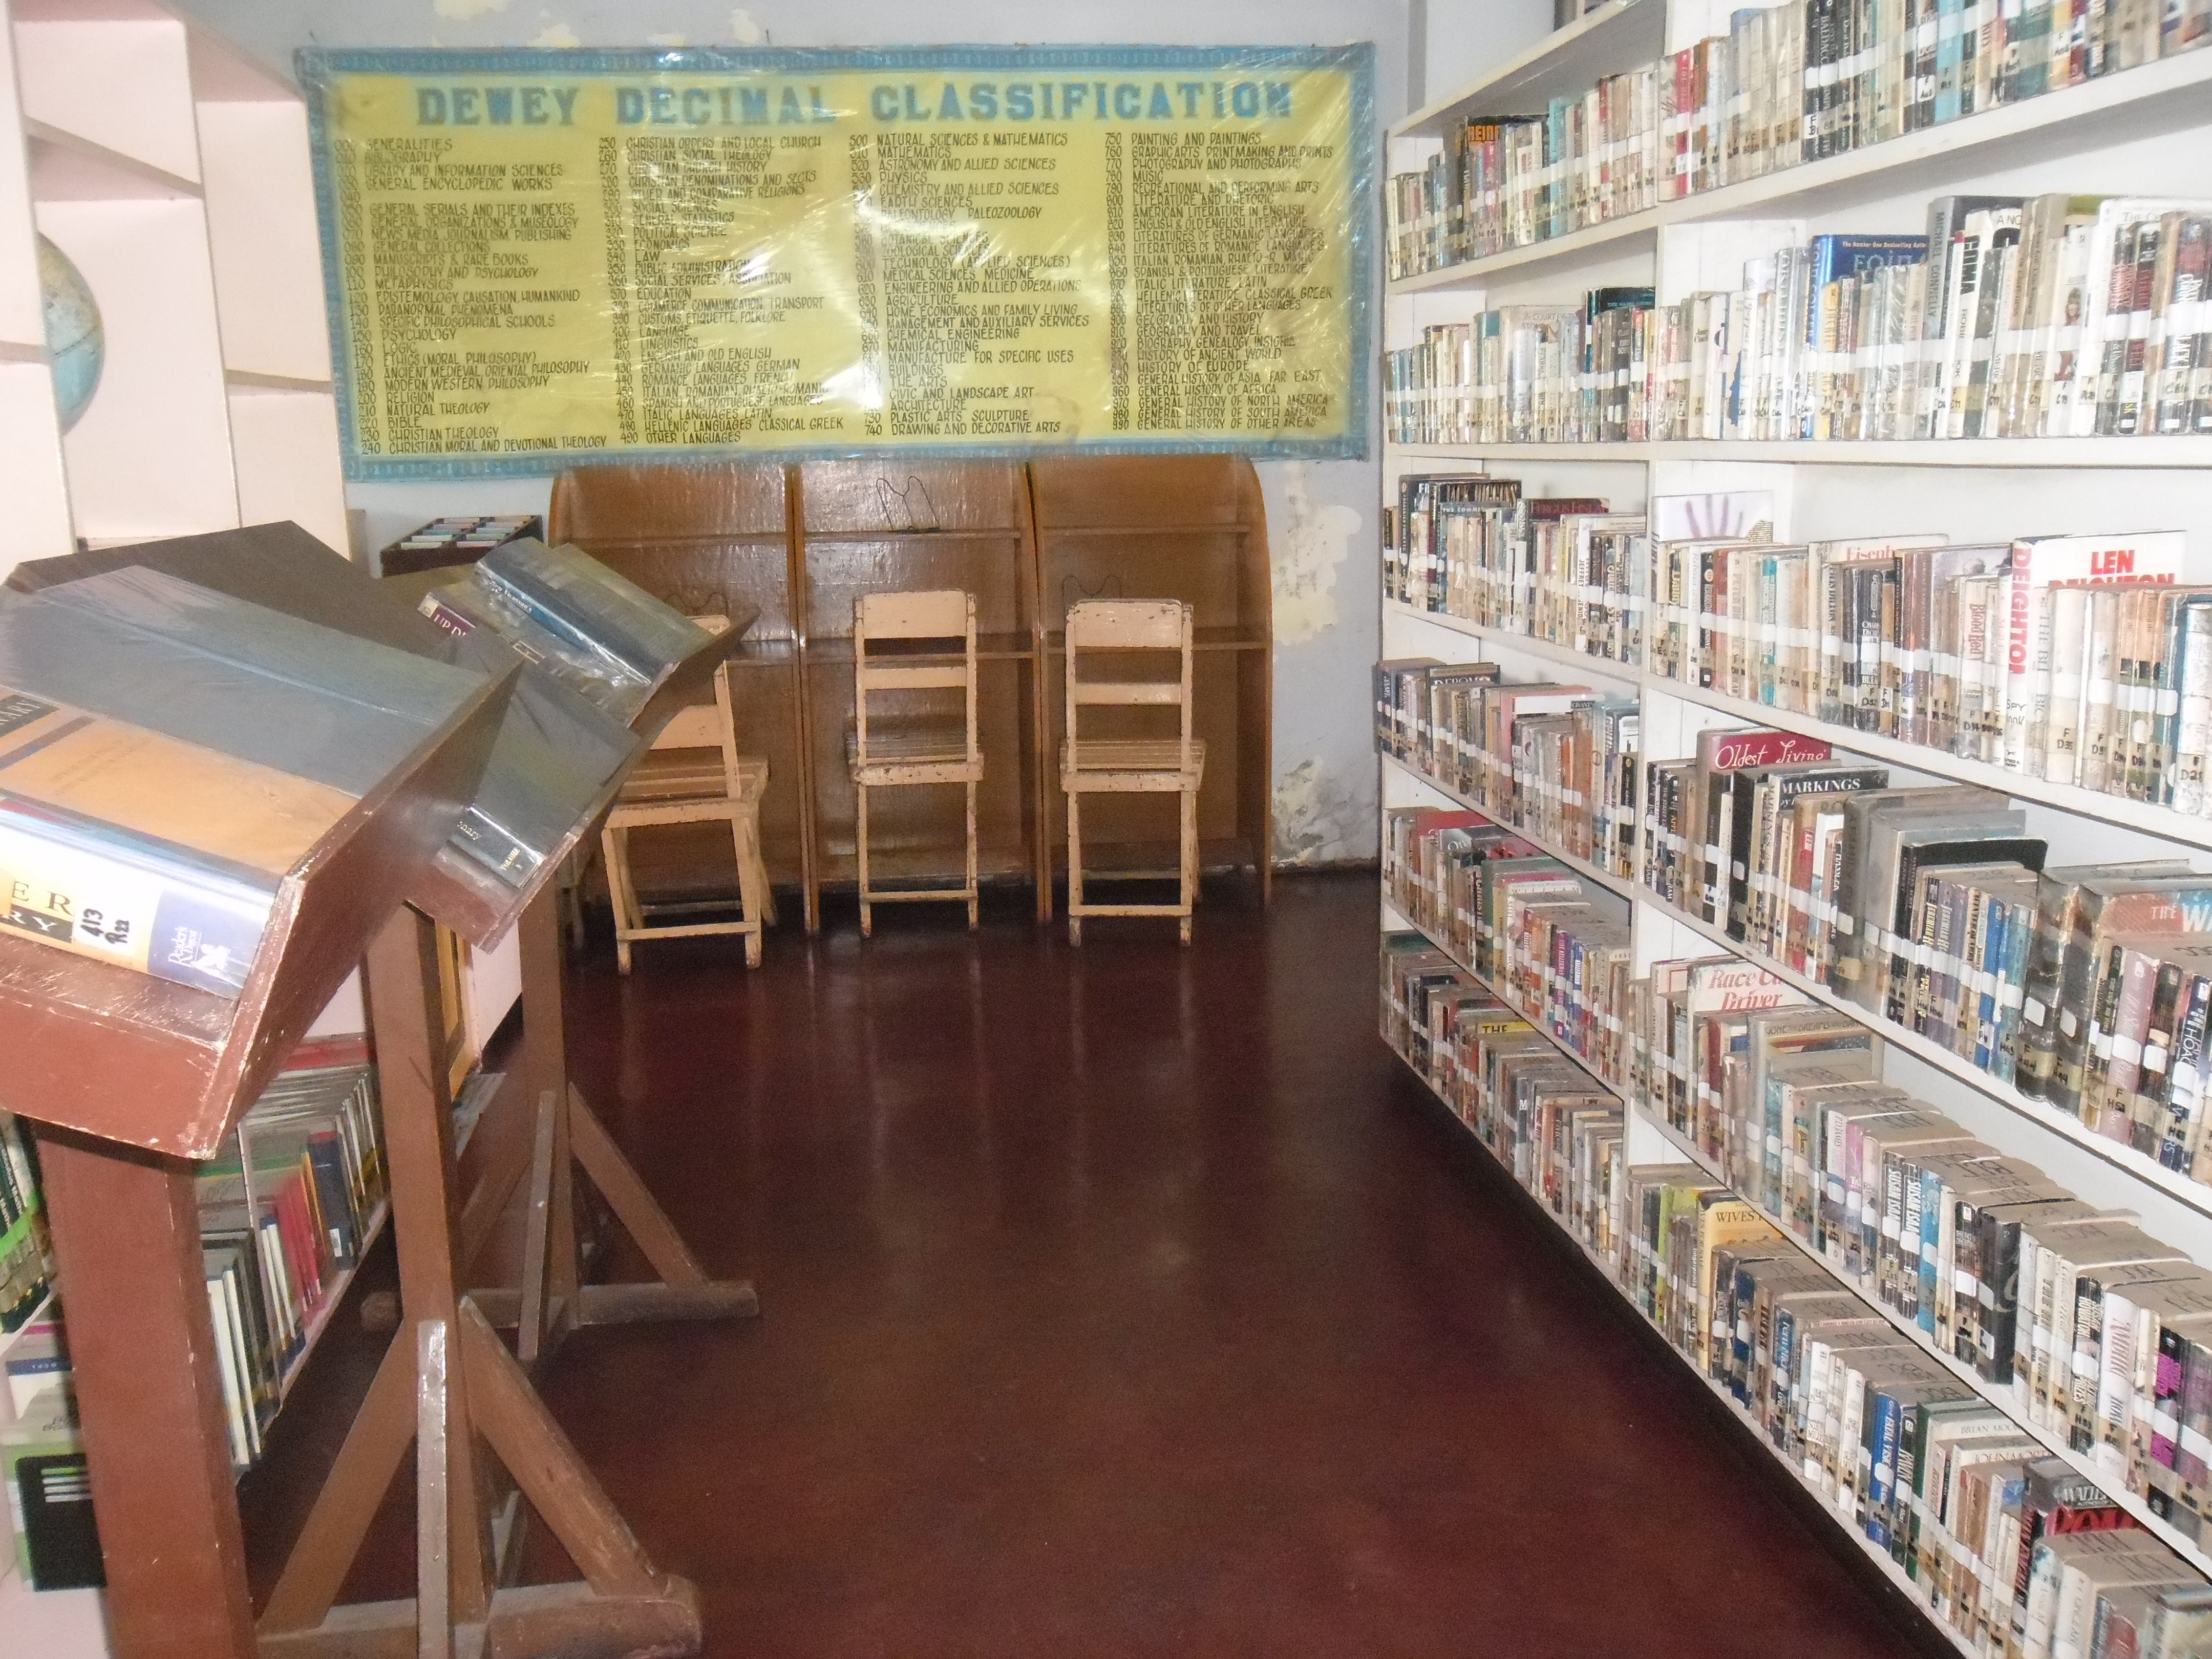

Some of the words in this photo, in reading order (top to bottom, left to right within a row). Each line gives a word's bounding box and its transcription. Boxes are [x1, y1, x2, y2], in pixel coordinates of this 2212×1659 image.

[1819, 15, 1831, 65] BALDACC
[416, 86, 580, 126] DEWEY
[617, 86, 836, 125] DECIMAL
[871, 82, 1291, 122] CLASSIFICATION
[850, 135, 867, 146] 500
[877, 134, 925, 146] NATURAL
[930, 133, 978, 146] SCIENCES
[983, 134, 990, 145] &
[994, 133, 1068, 145] MATHEMATICS
[1106, 133, 1121, 145] 750
[1132, 133, 1178, 145] PAINTING
[1184, 133, 1204, 145] AND
[1210, 133, 1261, 144] PAINTINGS
[852, 159, 868, 171] 520
[879, 159, 938, 171] ASTRONOMY
[941, 159, 960, 171] AND
[964, 158, 998, 170] ALLIED
[1005, 158, 1055, 170] SCIENCES
[1106, 159, 1121, 169] 770
[1133, 159, 1203, 170] PHOTOGRAPHY
[1207, 158, 1226, 169] AND
[852, 172, 870, 184] 530
[880, 172, 927, 184] PHYSICS
[1106, 171, 1122, 182] 780
[1133, 171, 1164, 182] MUSIC
[1108, 207, 1122, 218] 810
[1133, 206, 1183, 218] AMERICAN
[1188, 205, 1245, 217] LITERATURE
[1249, 205, 1259, 217] IN
[1263, 204, 1304, 216] ENGLISH
[1932, 211, 1946, 259] MICHAEL
[635, 251, 660, 262] LAW
[637, 288, 691, 299] EDUCATION
[1927, 265, 1941, 317] CONNELLY
[886, 294, 959, 306] AGRICULTURE
[860, 307, 877, 318] 640
[887, 307, 916, 317] HOME
[921, 306, 977, 316] ECONOMICS
[981, 306, 1000, 316] AND
[1005, 305, 1039, 316] FAMILY
[1045, 305, 1077, 315] LIVING
[353, 330, 371, 342] 150
[382, 329, 456, 341] PSYCHOLOGY
[1201, 326, 1221, 336] AND
[1225, 325, 1260, 336] TRAVEL
[354, 344, 372, 356] 160
[382, 342, 416, 354] LOGIC
[862, 342, 879, 352] 670
[888, 341, 979, 352] MANUFACTURING
[1138, 386, 1181, 397] GENERAL
[1185, 385, 1223, 395] HISTORY
[1227, 385, 1238, 394] OF
[1243, 384, 1276, 394] AFRICA
[358, 394, 376, 405] 200
[387, 392, 434, 403] RELIGION
[358, 406, 376, 417] 210
[387, 404, 435, 416] NATURAL
[441, 402, 490, 414] THEOLOGY
[618, 409, 634, 420] 470
[644, 409, 672, 421] ITALIC
[679, 409, 738, 420] LANGUAGES
[745, 409, 772, 419] LATIN
[620, 421, 635, 432] 480
[645, 421, 689, 432] HELLENIC
[694, 419, 752, 431] LANGUAGES
[759, 418, 805, 431] CLASSICAL
[810, 417, 843, 429] GREEK
[864, 413, 881, 424] 730
[891, 412, 930, 422] PLASTIC
[937, 411, 962, 422] ARTS
[972, 411, 1029, 421] SCULPTURE
[361, 431, 379, 442] 230
[389, 429, 442, 441] CHRISTIAN
[446, 427, 498, 439] THEOLOGY
[865, 424, 882, 436] 740
[892, 424, 941, 436] DRAWING
[944, 423, 966, 435] AND
[972, 422, 1032, 434] DECORATIVE
[1035, 422, 1060, 433] ARTS
[646, 432, 677, 443] OTHER
[684, 431, 740, 443] LANGUAGES
[362, 442, 380, 455] 240
[390, 442, 442, 454] CHRISTIAN
[446, 440, 477, 452] MORAL
[481, 439, 500, 451] AND
[504, 438, 558, 451] DEVOTIONAL
[562, 436, 606, 449] THEOLOGY
[1846, 545, 1895, 562] Eisenh
[2091, 549, 2135, 575] LEN
[2009, 547, 2032, 675] DEIGHTON
[1969, 604, 1986, 633] Blood
[1969, 634, 1984, 655] Red
[1715, 743, 1768, 769] Oldest
[1782, 778, 1860, 795] MARKINGS
[2151, 905, 2177, 920] THE
[80, 908, 104, 937] 413
[168, 926, 191, 967] Reader's
[1708, 969, 1757, 989] Race
[1758, 968, 1785, 986] Ca
[1721, 989, 1783, 1011] Driver
[1887, 1168, 1902, 1197] SUSAN
[1906, 1180, 1922, 1210] SUSAN
[1716, 1210, 1755, 1223] WIVES
[2077, 1296, 2092, 1338] HOWATCH
[1884, 1416, 1895, 1442] FATAL
[1961, 1424, 1989, 1434] BRIAN
[1974, 1452, 2003, 1464] JOHN
